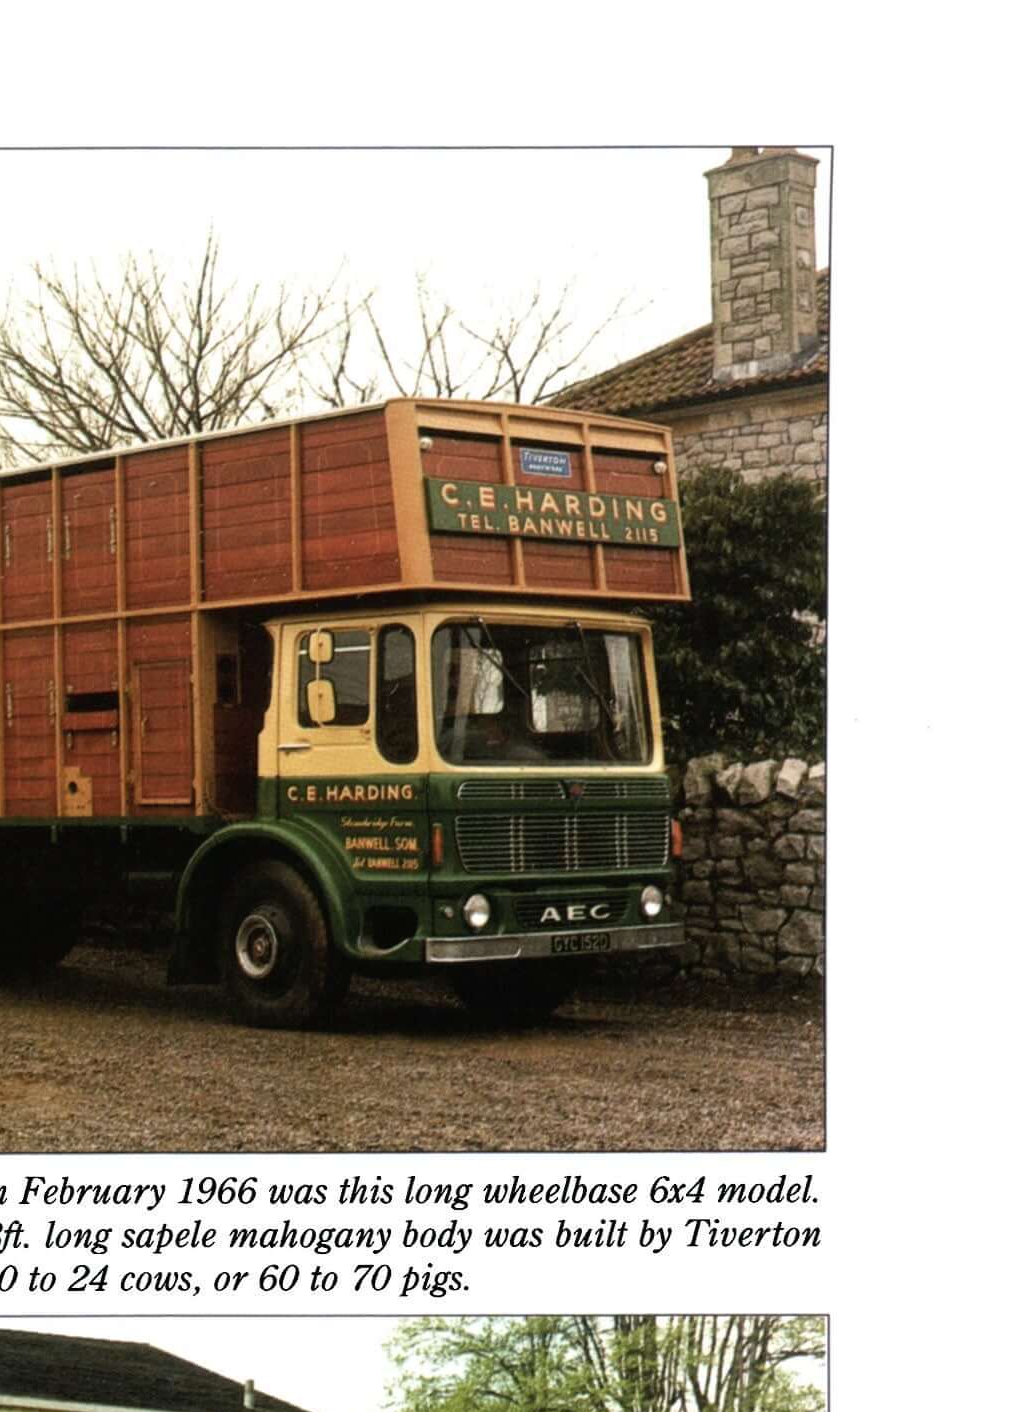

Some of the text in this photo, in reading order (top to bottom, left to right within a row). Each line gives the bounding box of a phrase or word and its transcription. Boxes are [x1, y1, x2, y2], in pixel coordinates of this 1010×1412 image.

[457, 513, 658, 543] TEL. BANWELL 2115
[540, 903, 610, 923] AEC
[18, 1176, 166, 1211] February
[177, 1176, 258, 1205] 1966
[268, 1184, 328, 1205] was
[338, 1175, 394, 1205] this
[404, 1175, 474, 1211] long
[482, 1175, 638, 1205] wheelbase
[649, 1175, 706, 1204] 6x4
[717, 1174, 818, 1204] model.
[45, 1220, 113, 1255] long
[121, 1219, 217, 1255] sapele
[229, 1219, 392, 1255] mahogany
[402, 1219, 473, 1255] body
[484, 1227, 544, 1248] was
[555, 1218, 629, 1248] built
[639, 1219, 673, 1254] by
[684, 1218, 821, 1248] Tiverton
[28, 1266, 57, 1293] to
[67, 1264, 109, 1292] 24
[120, 1271, 201, 1297] cows,
[213, 1271, 249, 1292] or
[259, 1263, 300, 1292] 60
[310, 1265, 339, 1292] to
[353, 1264, 392, 1292] 70
[399, 1262, 469, 1298] pigs.
